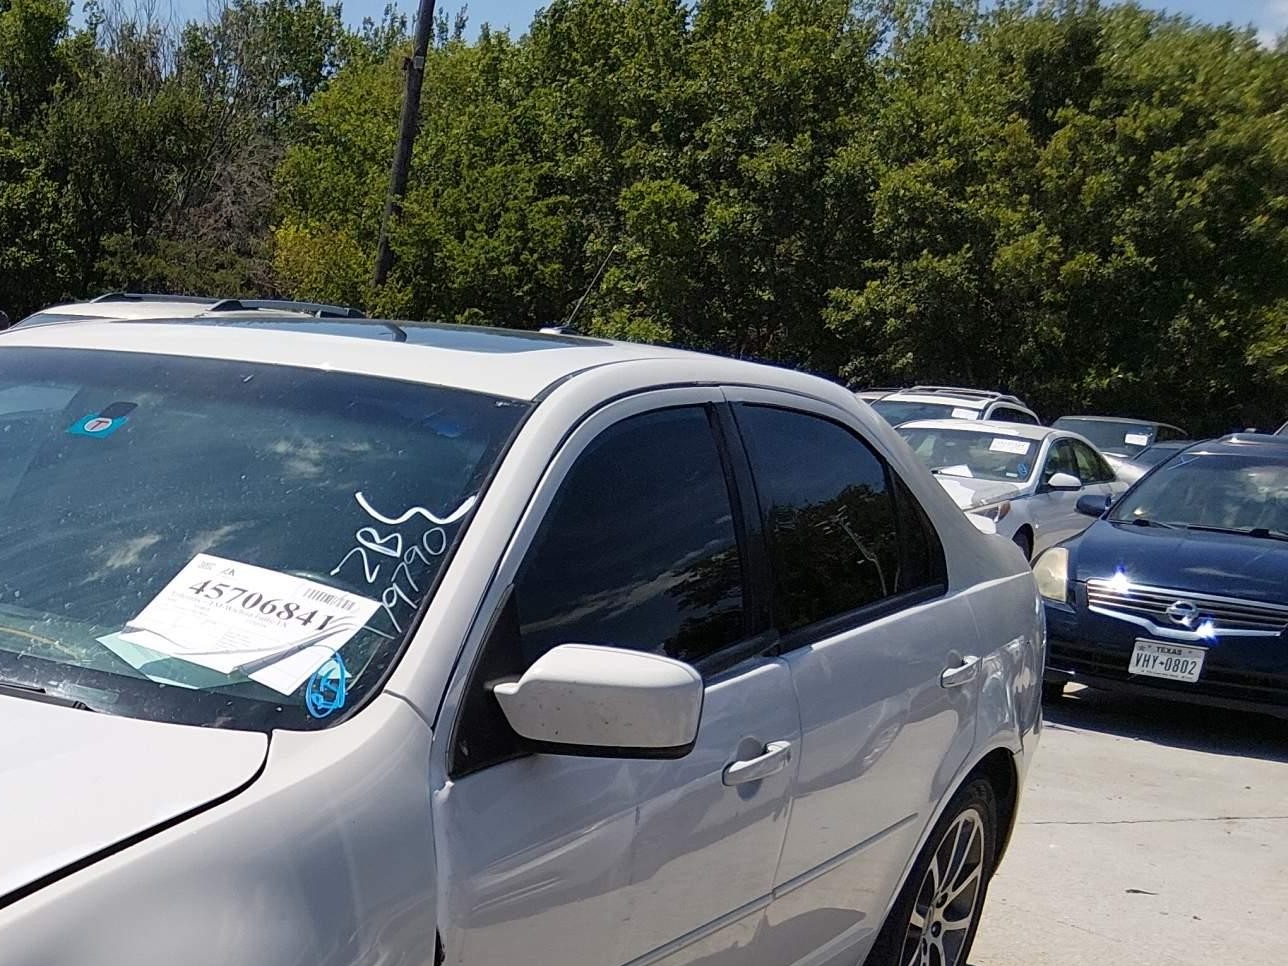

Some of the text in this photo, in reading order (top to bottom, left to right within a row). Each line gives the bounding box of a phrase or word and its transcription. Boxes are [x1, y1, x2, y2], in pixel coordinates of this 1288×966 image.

[329, 527, 402, 583] 2B
[188, 579, 334, 631] 45706841
[1156, 646, 1183, 656] TEXAS
